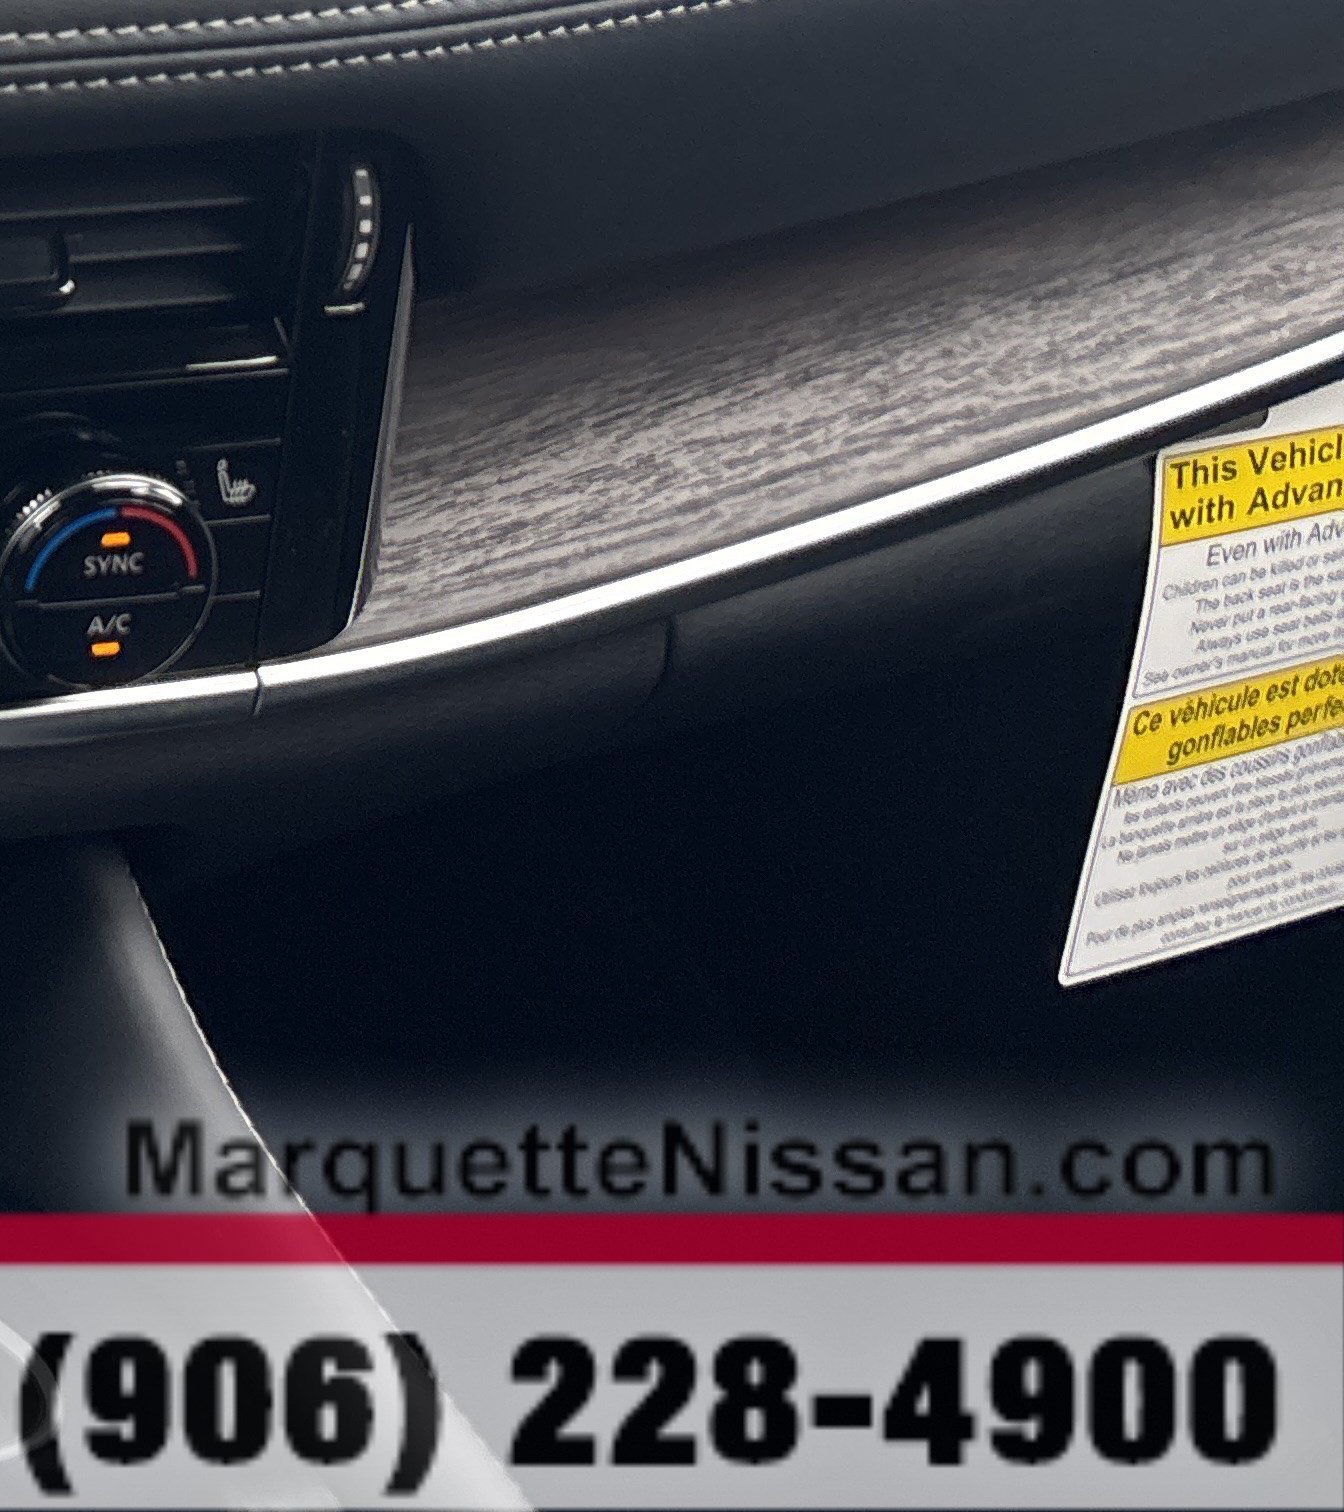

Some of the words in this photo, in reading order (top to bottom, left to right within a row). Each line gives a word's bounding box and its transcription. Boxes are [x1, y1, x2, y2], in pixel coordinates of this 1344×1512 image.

[1169, 455, 1237, 491] This
[1170, 494, 1234, 530] with
[1246, 479, 1343, 516] Advan
[84, 551, 144, 576] SYNC
[1205, 538, 1256, 567] Even
[1263, 527, 1302, 554] with
[86, 613, 132, 635] A/C
[1133, 708, 1163, 737] Ce
[1169, 684, 1261, 728] véhicule
[1266, 673, 1299, 703] est
[1166, 714, 1281, 767] gonflables
